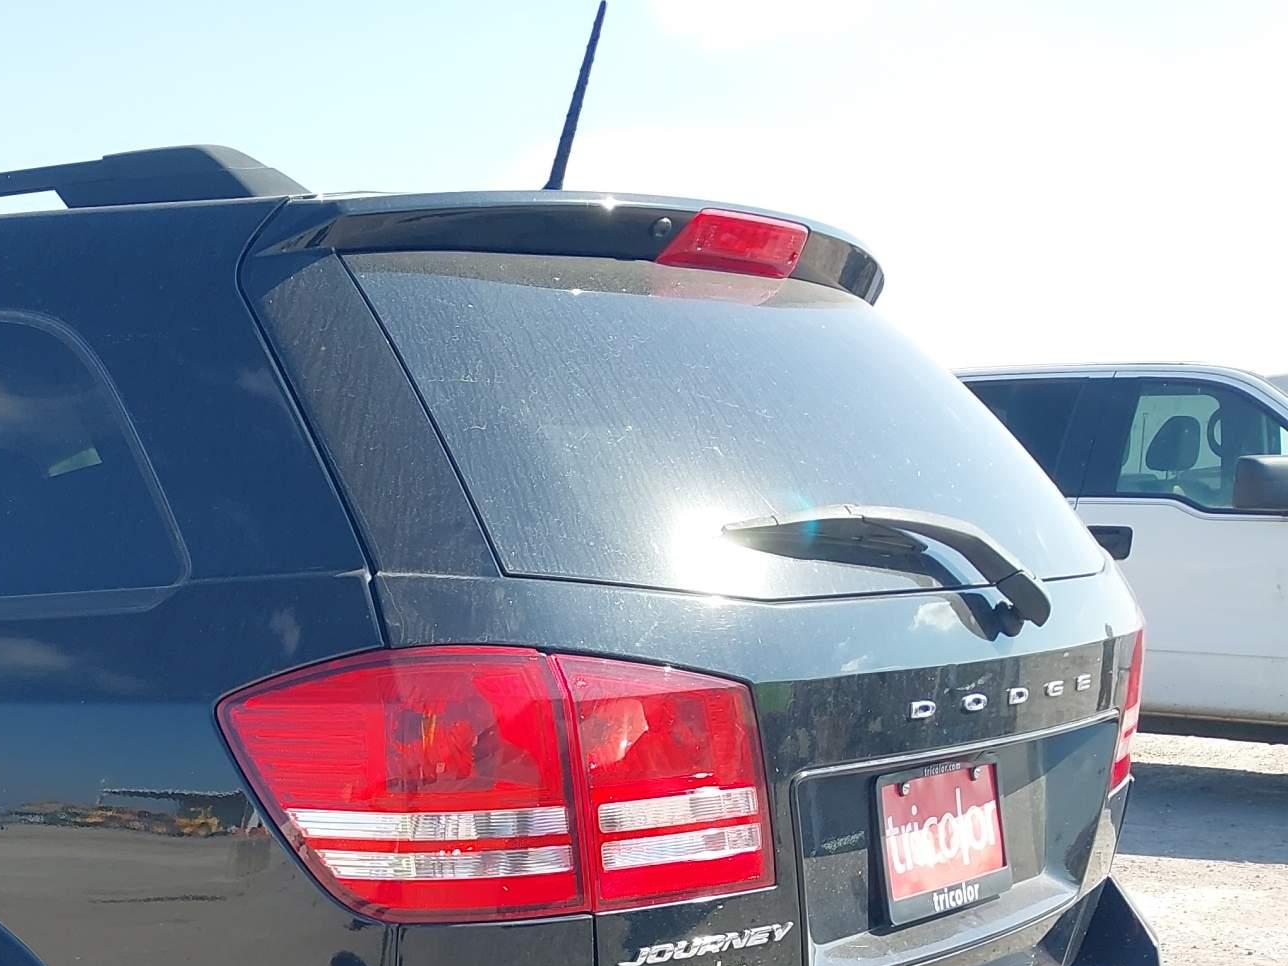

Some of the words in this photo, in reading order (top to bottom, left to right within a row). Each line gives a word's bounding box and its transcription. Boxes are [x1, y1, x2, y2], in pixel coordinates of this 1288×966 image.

[909, 673, 1092, 720] DODGE
[924, 762, 961, 777] tricolor.com
[885, 787, 997, 874] tricolor
[932, 882, 980, 912] tricolor
